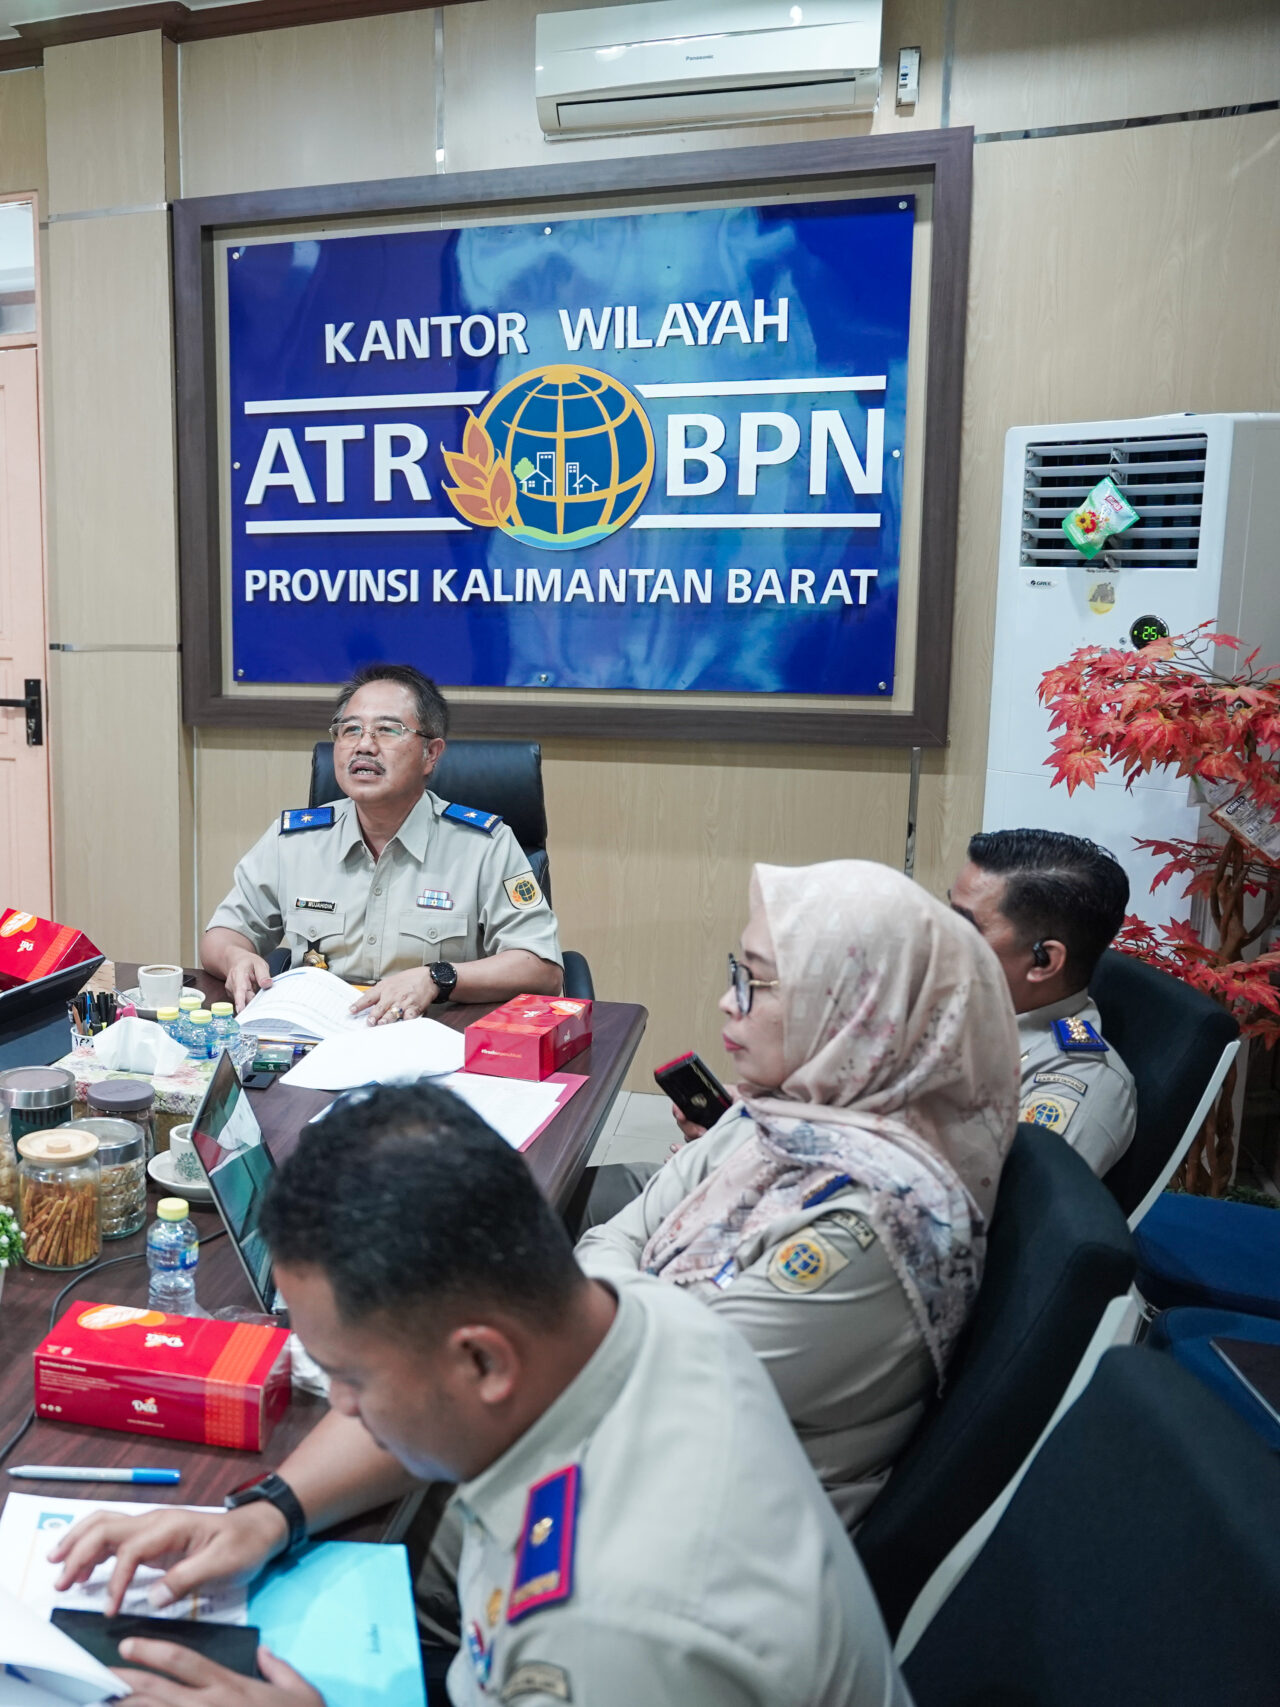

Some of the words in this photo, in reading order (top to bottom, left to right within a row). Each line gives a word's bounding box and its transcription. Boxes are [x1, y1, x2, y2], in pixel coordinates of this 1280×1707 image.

[324, 311, 528, 364] KANTOR
[559, 297, 790, 351] WILAYAH
[245, 420, 431, 505] ATR
[665, 409, 885, 498] BPN
[244, 567, 420, 603] PROVINSI
[432, 567, 713, 604] KALIMANTAN
[726, 569, 878, 605] BARAT
[1142, 626, 1158, 640] 25
